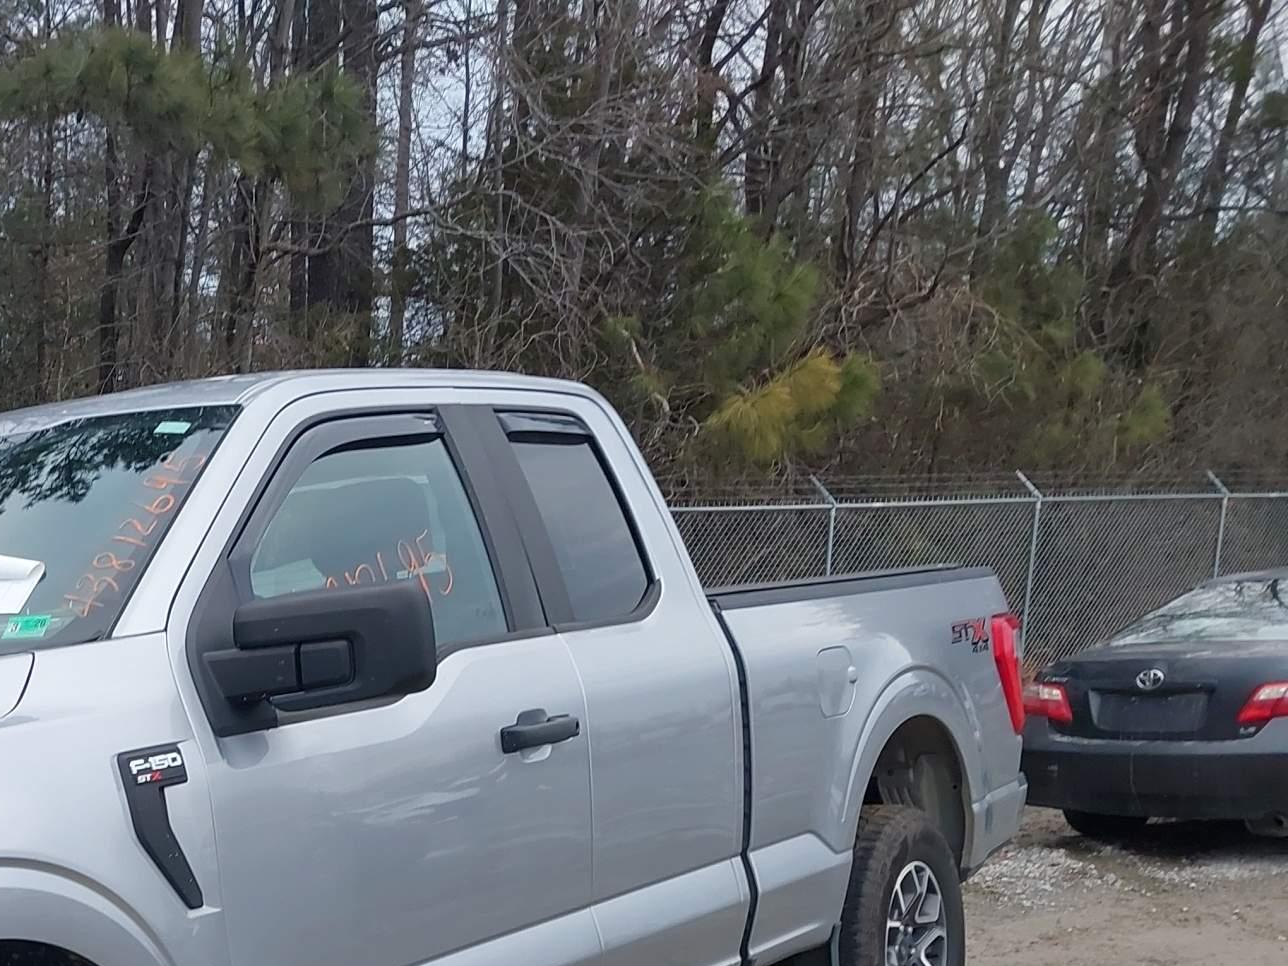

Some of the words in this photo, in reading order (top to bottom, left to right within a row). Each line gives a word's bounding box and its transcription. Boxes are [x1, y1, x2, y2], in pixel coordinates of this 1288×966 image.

[62, 454, 207, 617] 43812695
[951, 617, 989, 645] STX
[129, 752, 182, 774] F-150
